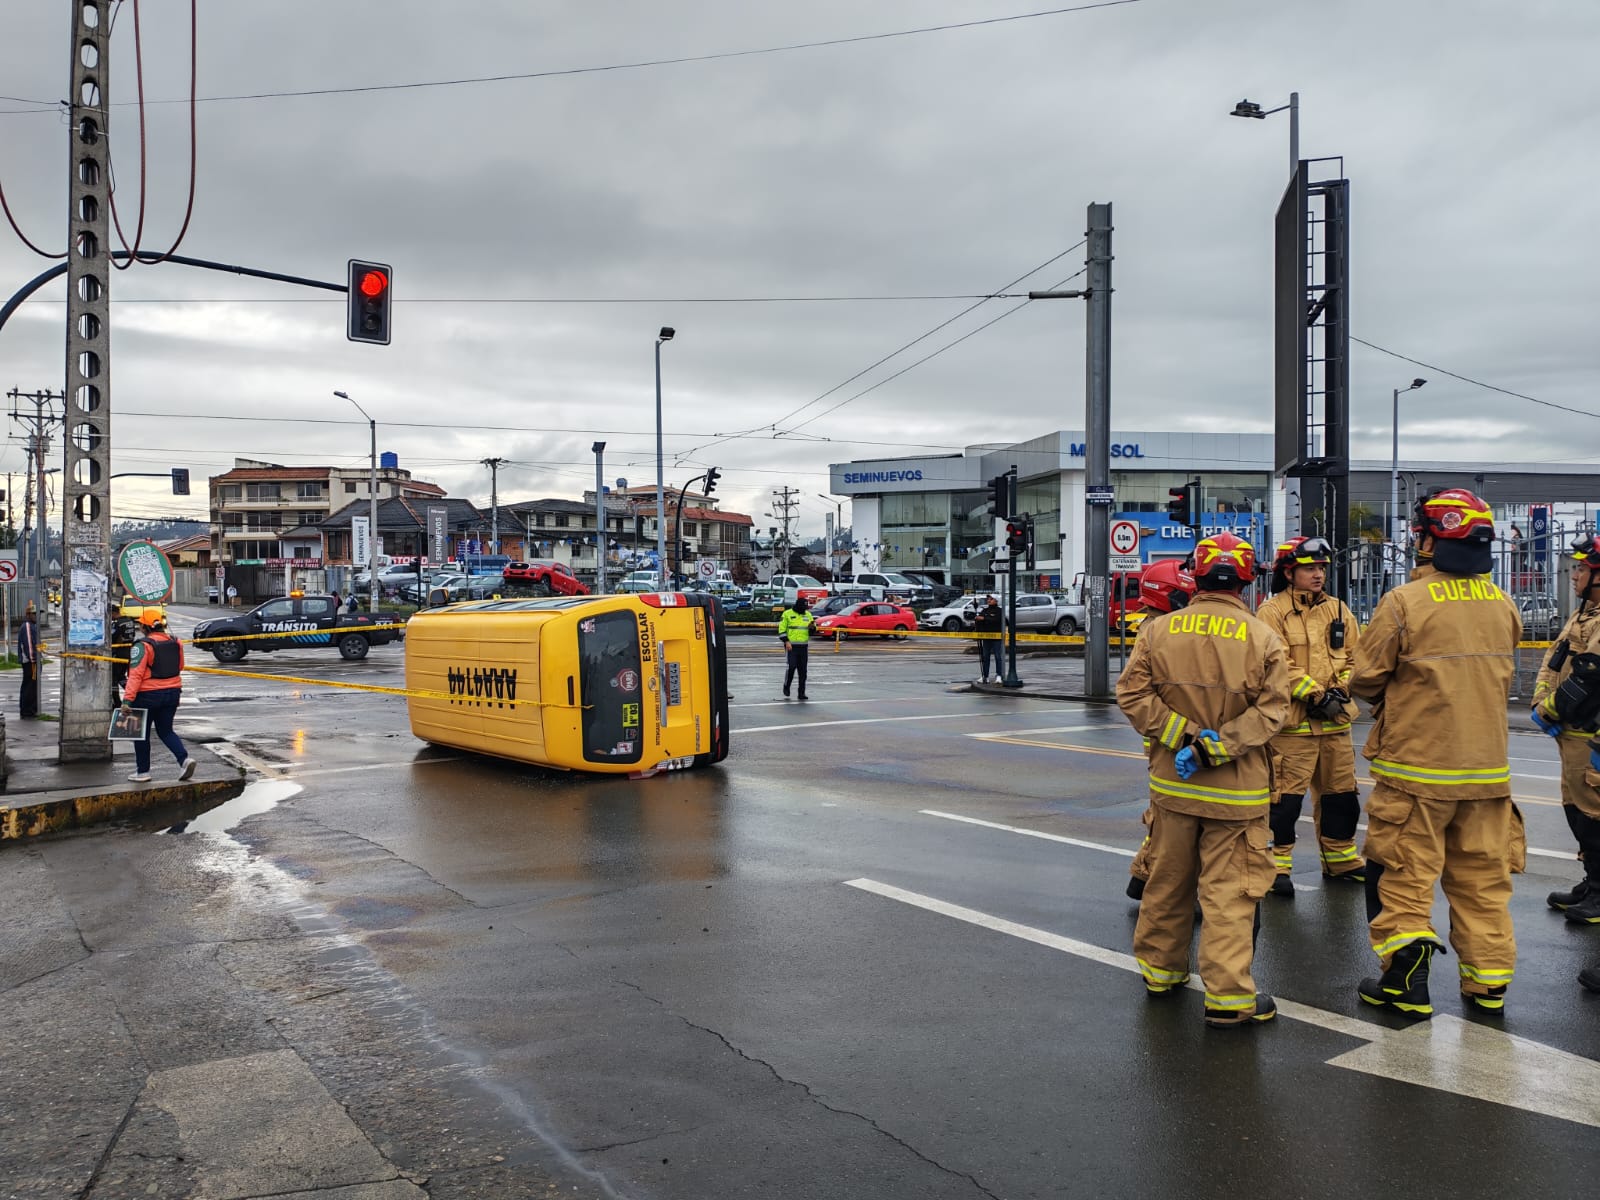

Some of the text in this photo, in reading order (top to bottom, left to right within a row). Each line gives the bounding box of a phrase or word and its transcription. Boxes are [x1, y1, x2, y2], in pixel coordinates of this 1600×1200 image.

[1070, 443, 1144, 458] MSOL
[844, 470, 923, 483] SEMINUEVOS
[1427, 578, 1504, 603] CUENCA
[261, 621, 318, 632] TRÁNSITO
[1169, 613, 1247, 642] CUENCA
[639, 612, 651, 662] ESCOLAR
